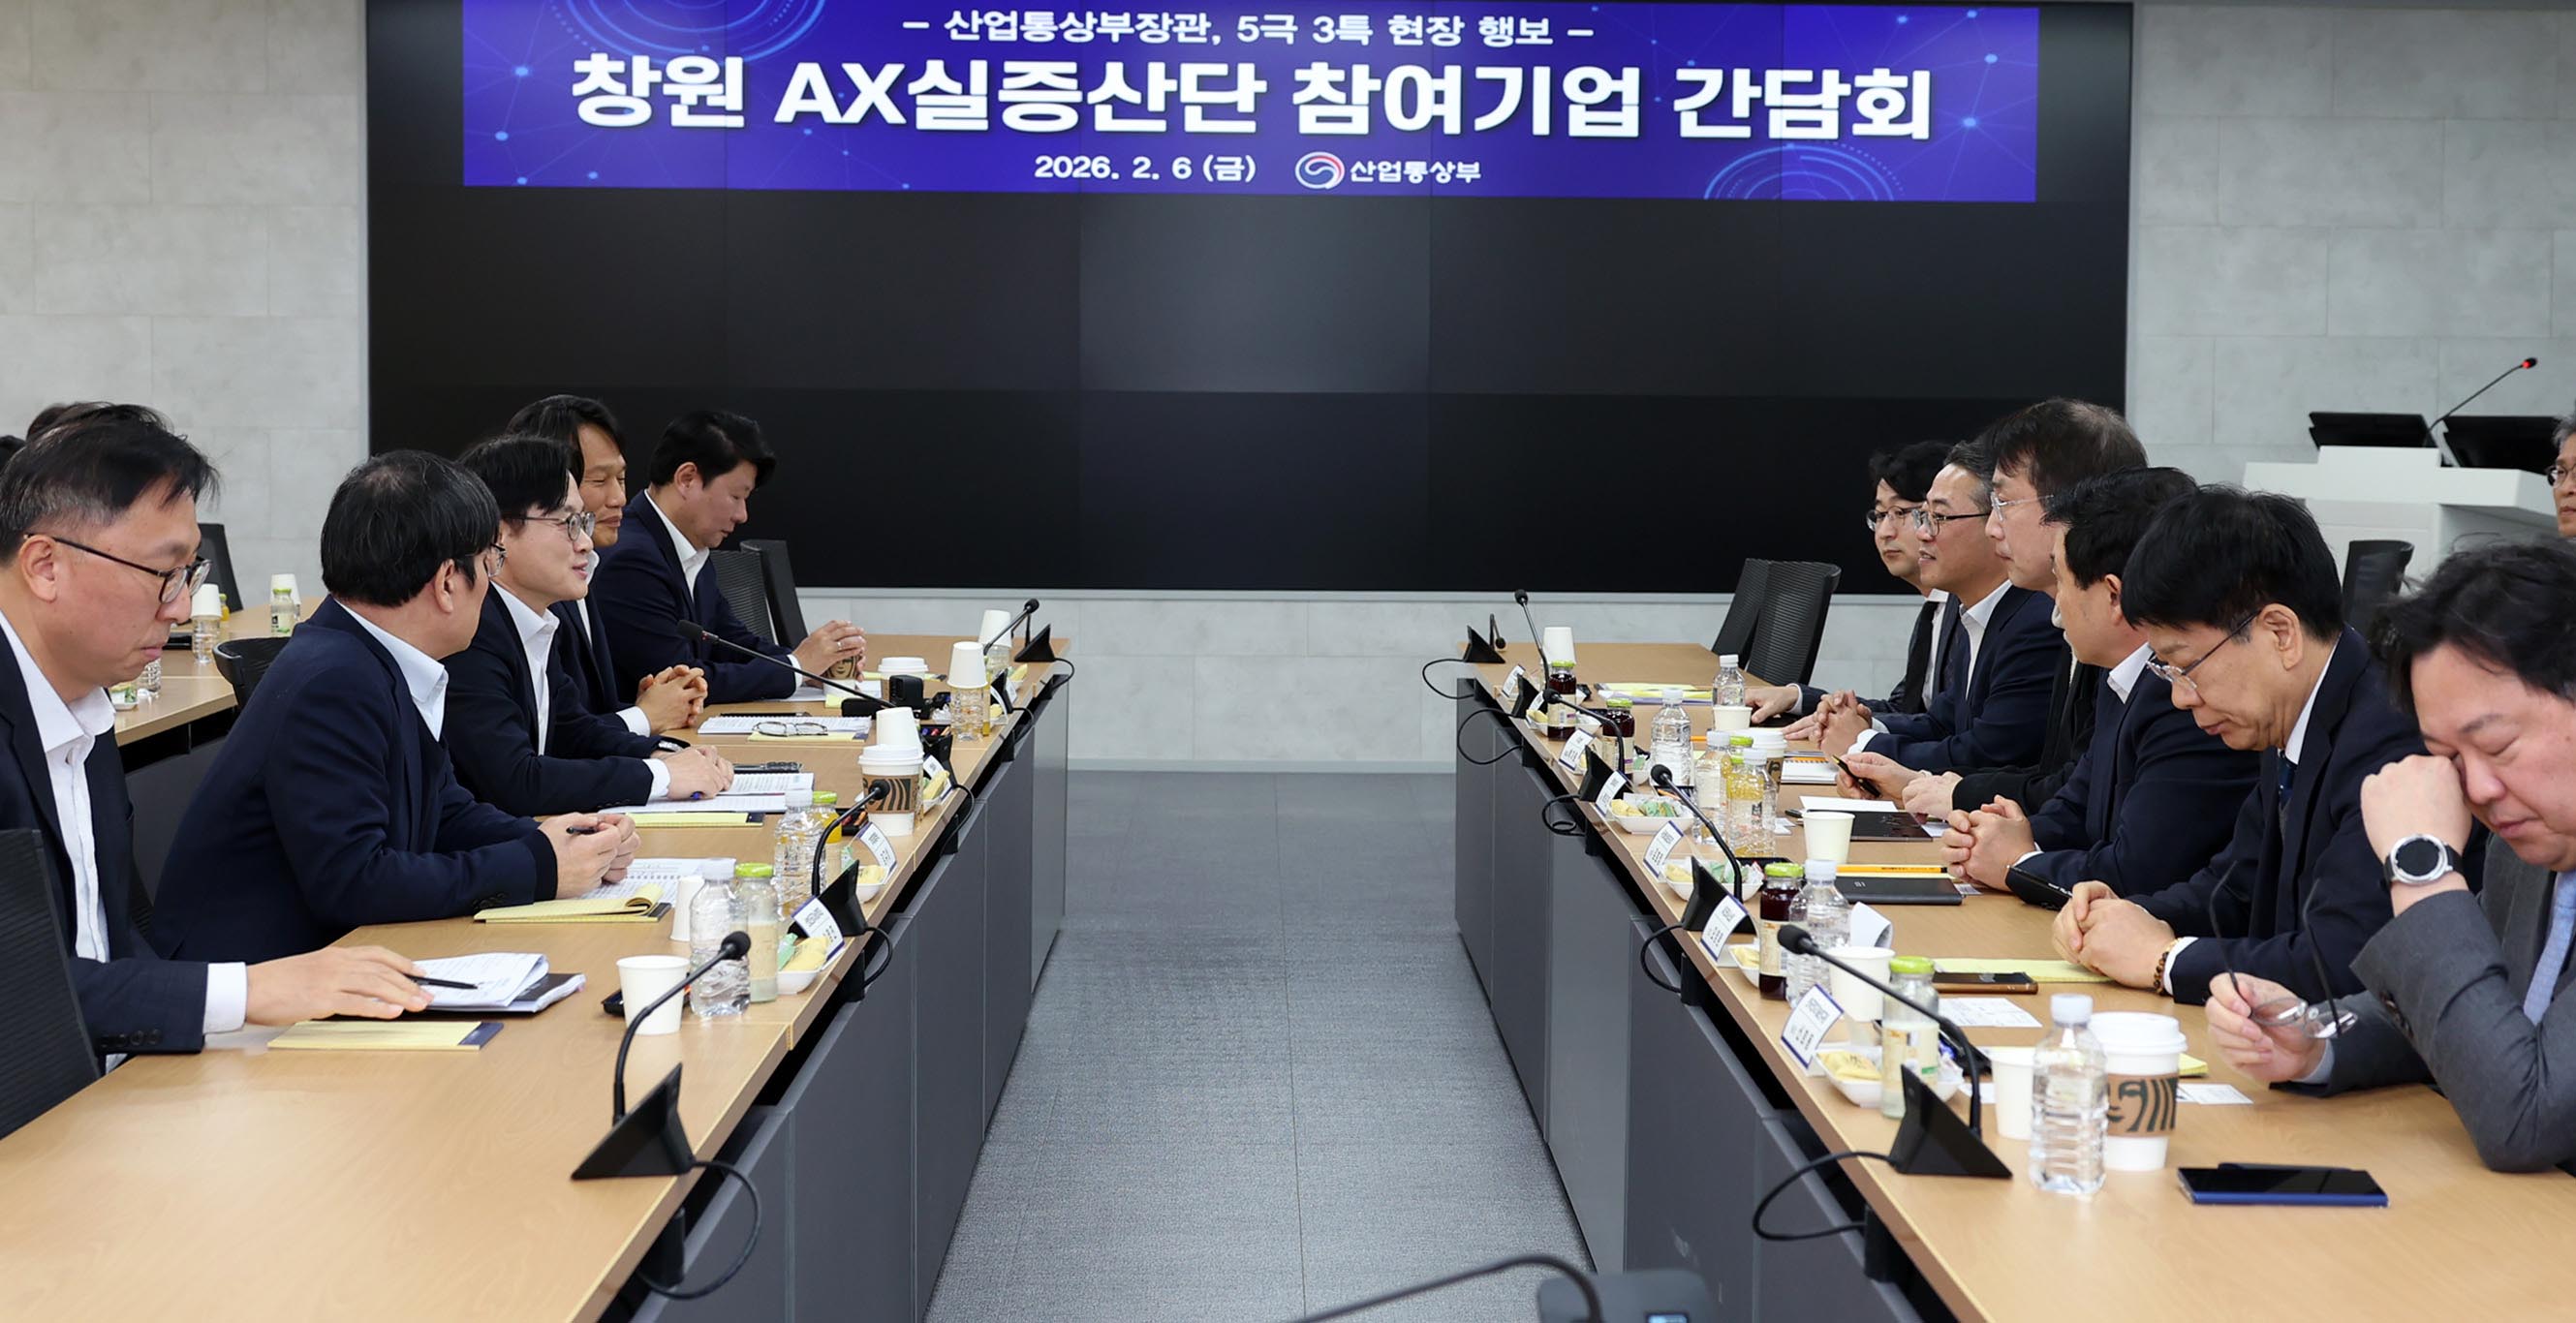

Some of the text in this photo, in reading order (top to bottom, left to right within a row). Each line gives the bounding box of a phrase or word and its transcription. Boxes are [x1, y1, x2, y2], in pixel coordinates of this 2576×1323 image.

[944, 10, 1223, 46] 산업통상부장관,
[1236, 14, 1299, 46] 5극
[1312, 14, 1374, 46] 3특
[1387, 14, 1466, 47] 현장
[1477, 15, 1554, 47] 행보
[572, 52, 1931, 140] 창원 AX실증산단 참여기업 간담회
[1034, 154, 1257, 183] 2026. 2. 6 (금)
[1350, 160, 1481, 184] 산업통상부
